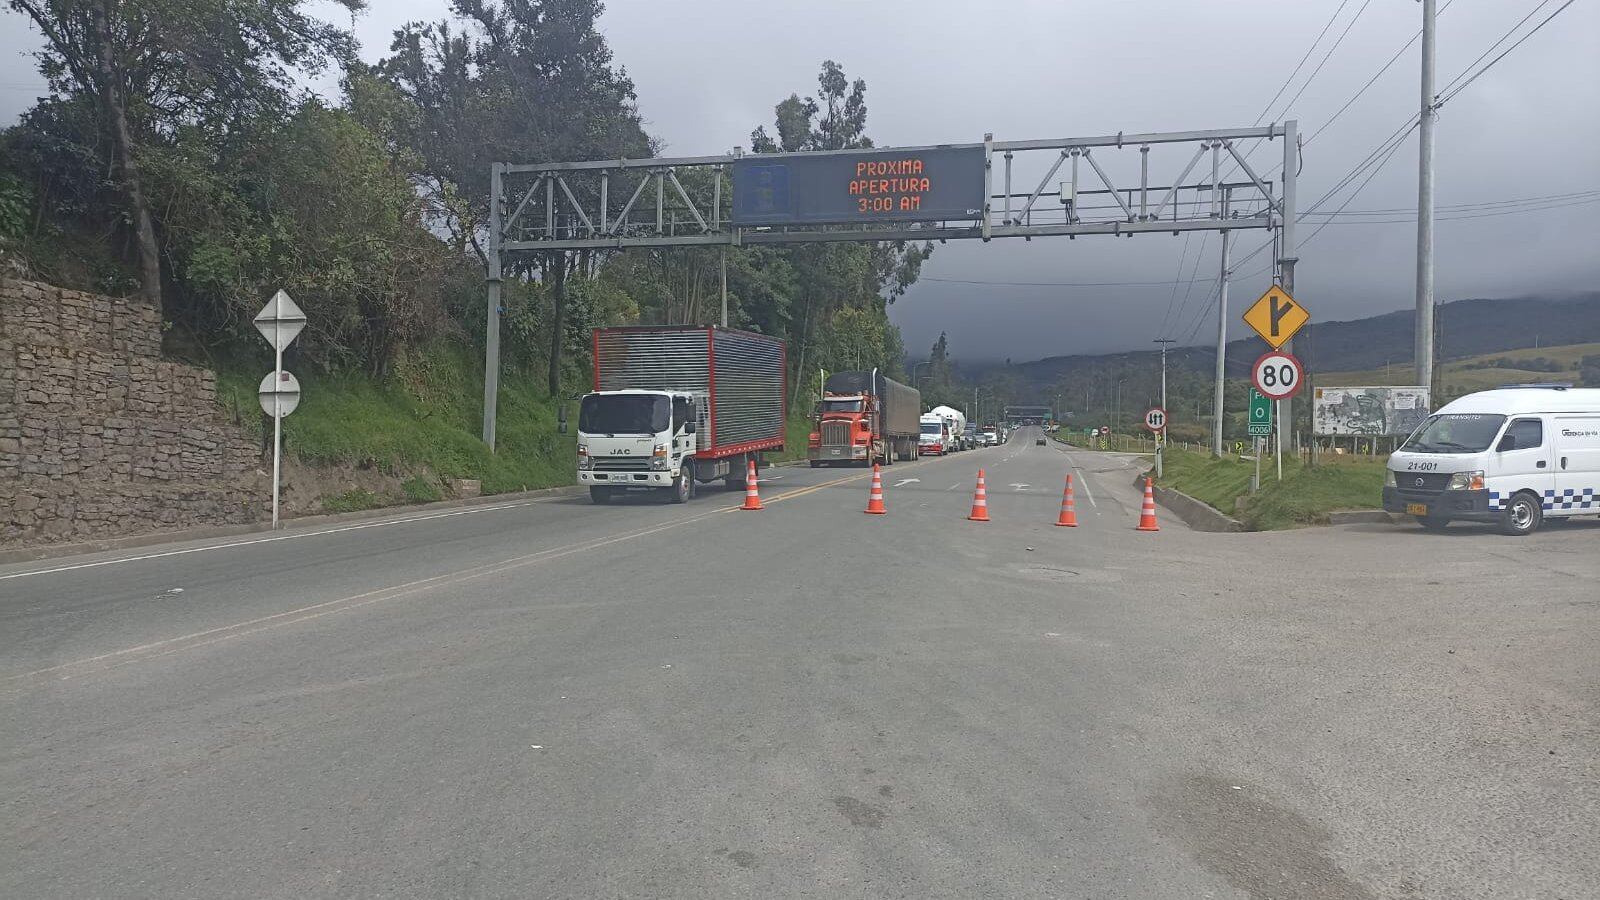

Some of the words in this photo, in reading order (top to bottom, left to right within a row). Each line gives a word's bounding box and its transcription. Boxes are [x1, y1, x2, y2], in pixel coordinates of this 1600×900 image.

[857, 160, 922, 176] PROXIMA
[849, 178, 930, 195] APERTURA
[858, 197, 893, 212] 3:00
[900, 196, 920, 211] AM
[1264, 365, 1293, 386] 80
[1250, 426, 1269, 434] 4006
[1407, 462, 1438, 470] 21-001
